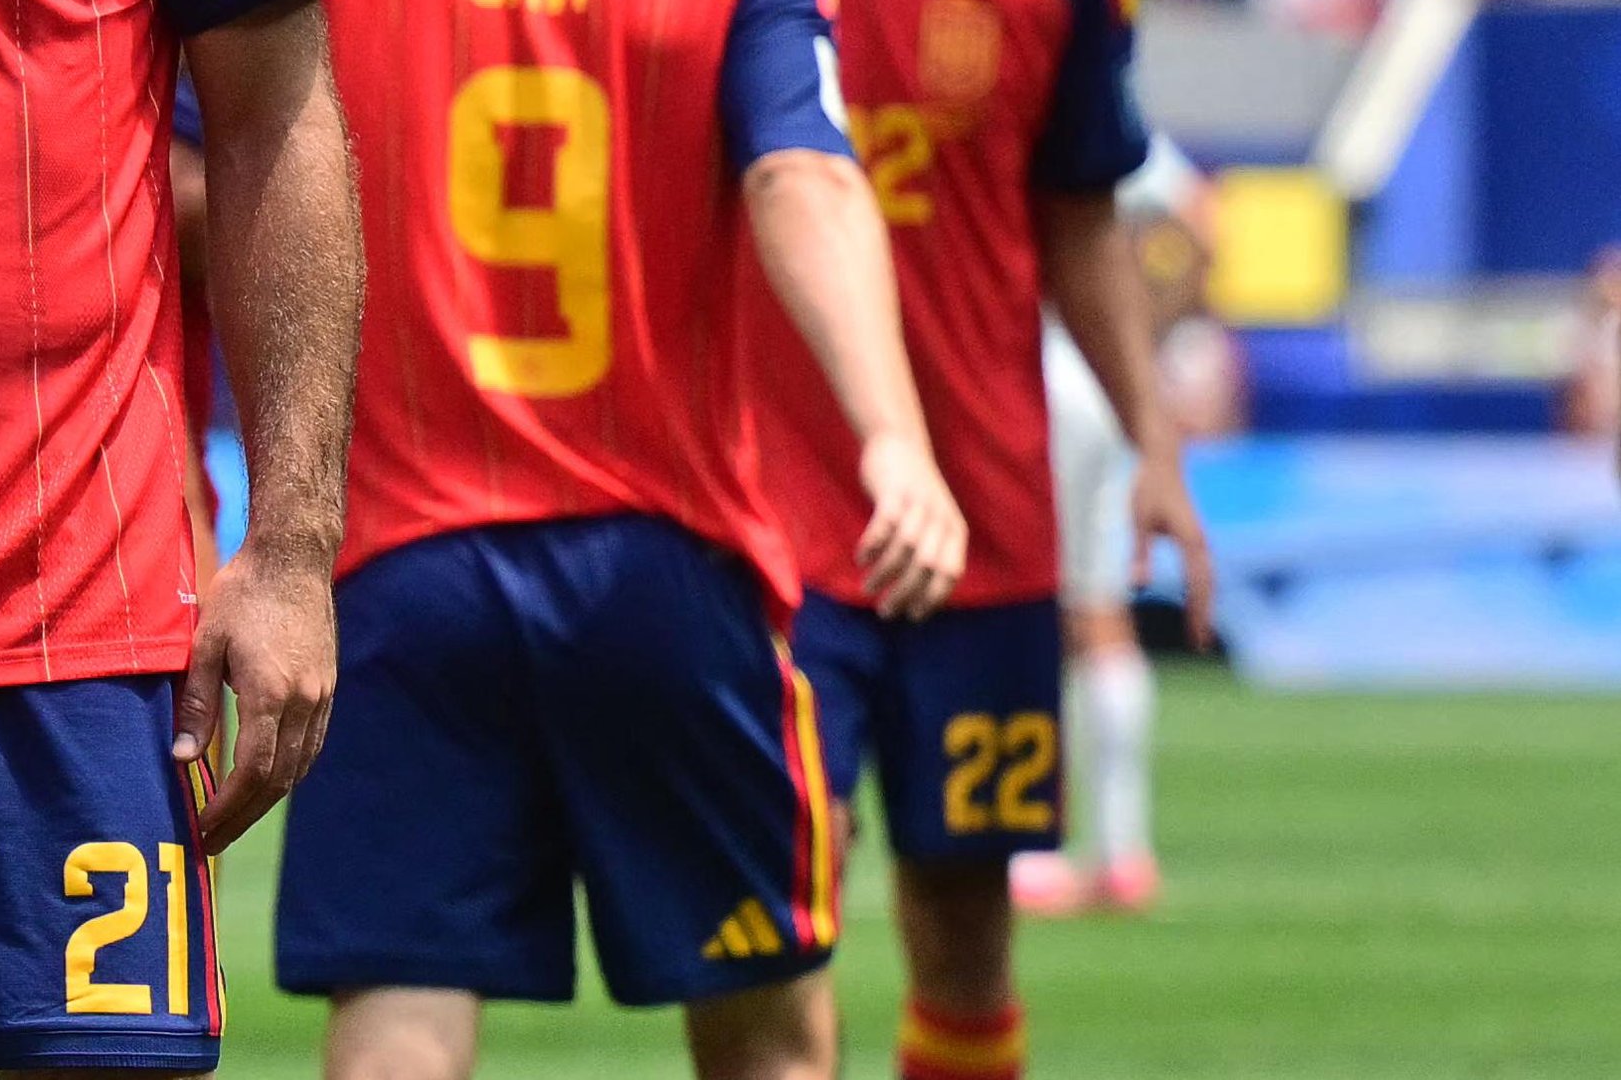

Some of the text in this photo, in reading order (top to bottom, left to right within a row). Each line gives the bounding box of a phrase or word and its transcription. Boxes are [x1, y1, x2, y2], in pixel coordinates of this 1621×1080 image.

[449, 65, 611, 398] 9
[944, 712, 1056, 834] 22
[64, 842, 188, 1015] 21
